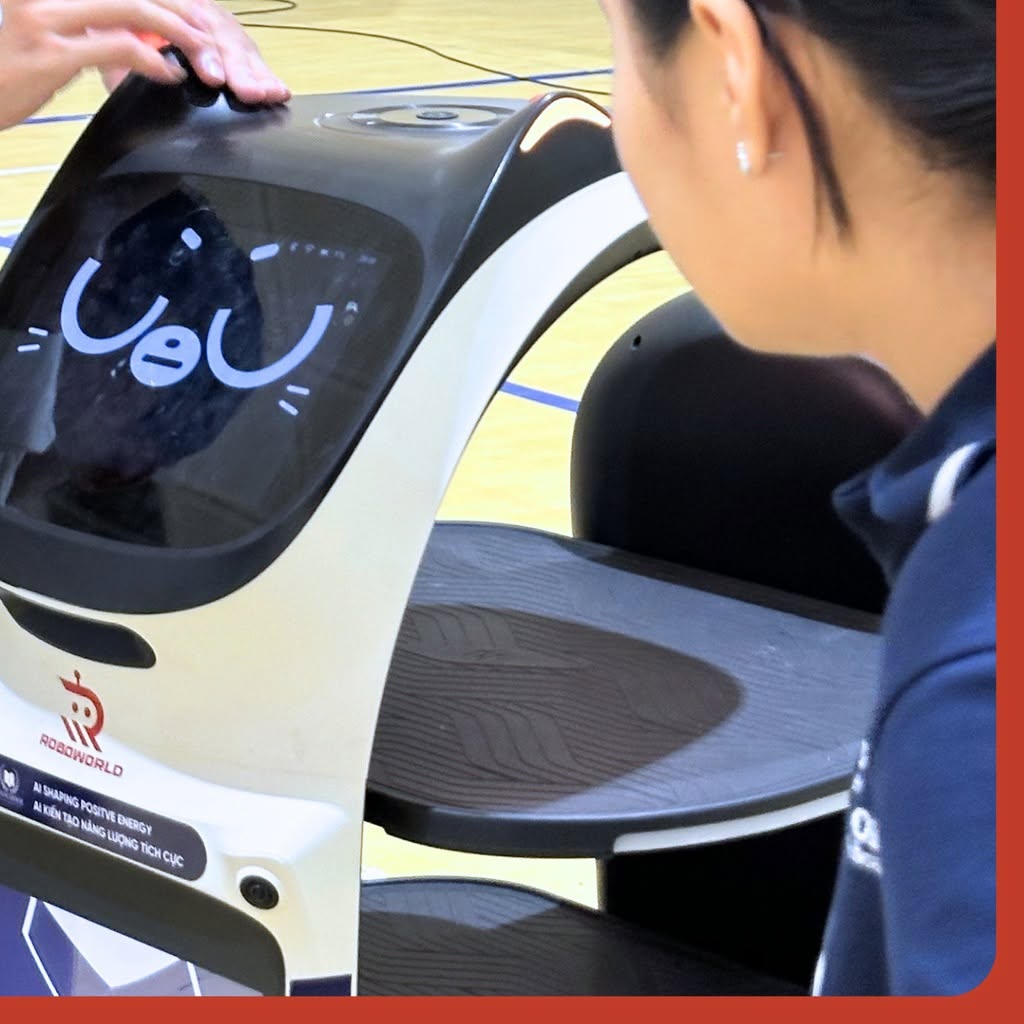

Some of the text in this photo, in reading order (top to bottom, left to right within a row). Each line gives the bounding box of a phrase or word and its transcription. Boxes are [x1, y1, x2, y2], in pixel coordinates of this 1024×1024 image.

[39, 733, 124, 777] ROBOWORLD
[33, 800, 42, 813] AI
[33, 781, 42, 794] AI
[43, 785, 79, 809] SHAPING
[117, 813, 152, 836] ENERGY
